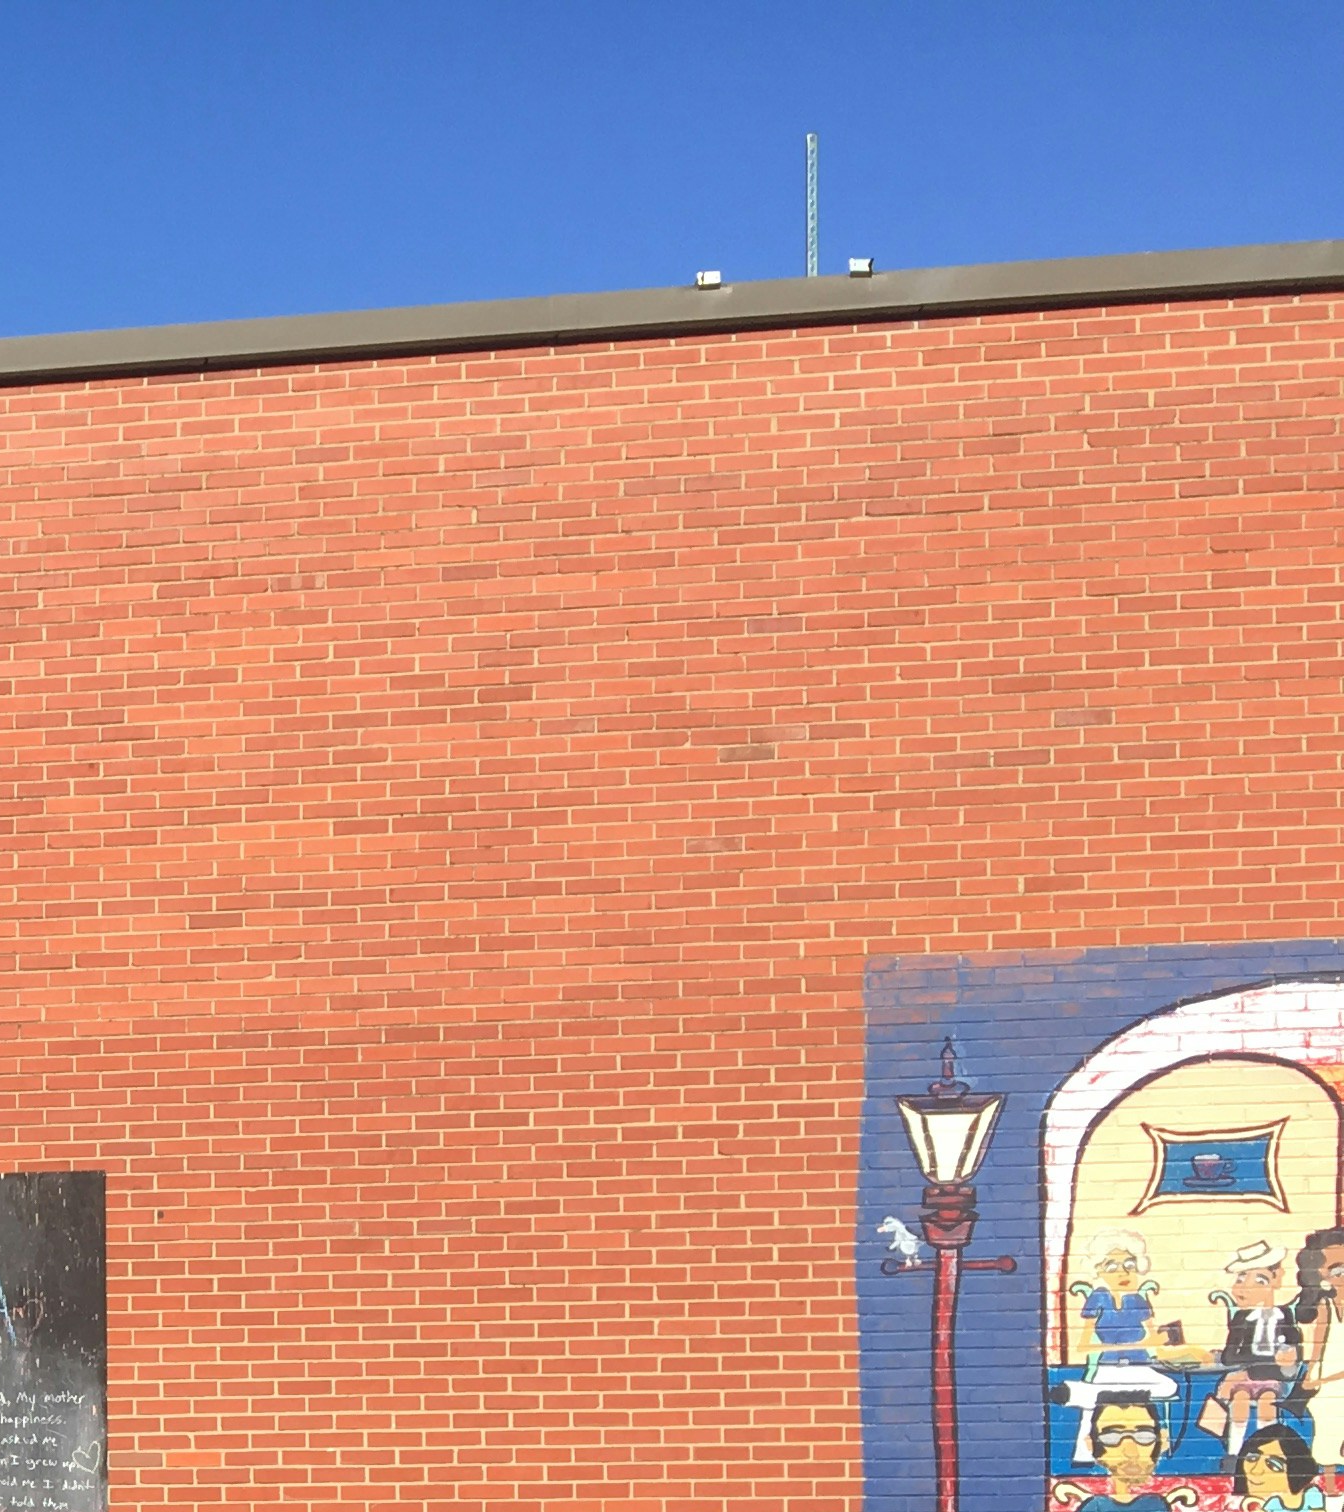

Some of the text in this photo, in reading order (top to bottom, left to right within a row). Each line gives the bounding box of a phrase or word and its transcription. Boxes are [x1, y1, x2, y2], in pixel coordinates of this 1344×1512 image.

[43, 1391, 87, 1407] mother
[25, 1458, 59, 1472] grew
[43, 1479, 55, 1490] I
[11, 1496, 36, 1508] told
